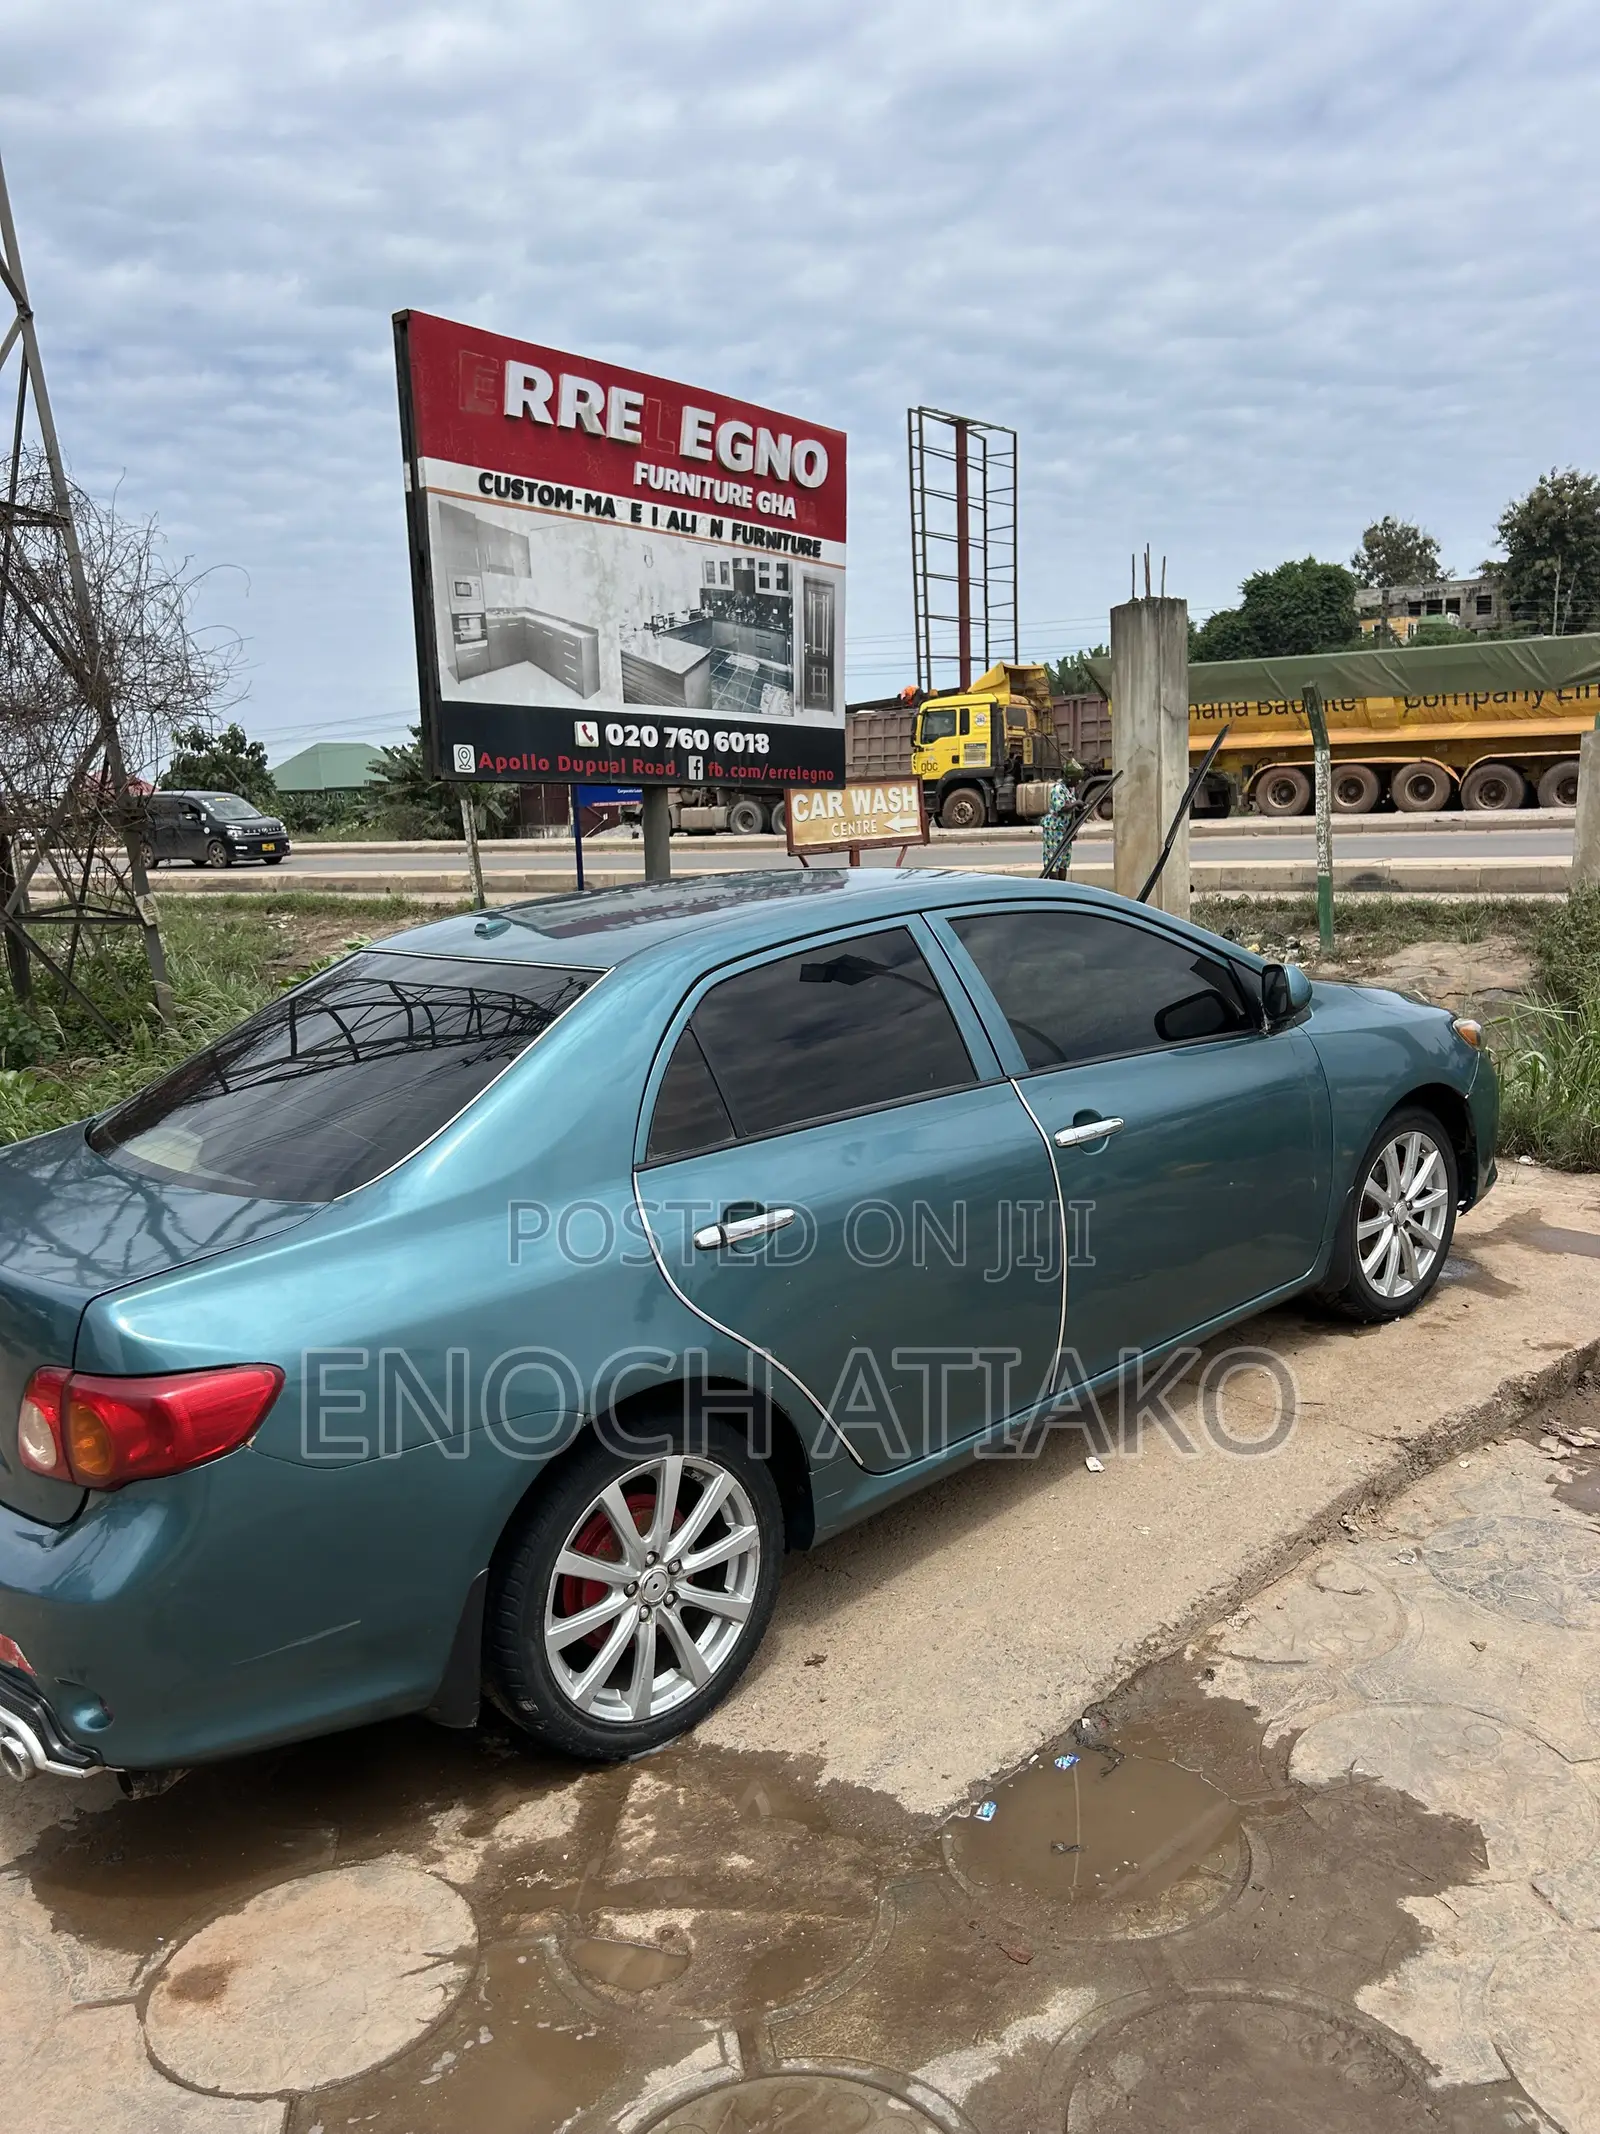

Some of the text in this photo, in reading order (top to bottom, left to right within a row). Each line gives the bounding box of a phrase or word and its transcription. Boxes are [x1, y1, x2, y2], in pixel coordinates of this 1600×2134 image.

[633, 461, 754, 509] FURNITURE
[478, 472, 822, 558] CUSTOM-MAE IALIN FURNITURE
[604, 723, 770, 754] 020 760 6018
[478, 752, 550, 773] Apollo
[558, 756, 626, 776] Dupual
[708, 762, 834, 781] fb.com/errelegno
[921, 760, 938, 775] gbc
[792, 786, 918, 822] CAR WASH
[831, 819, 878, 838] CENTRE
